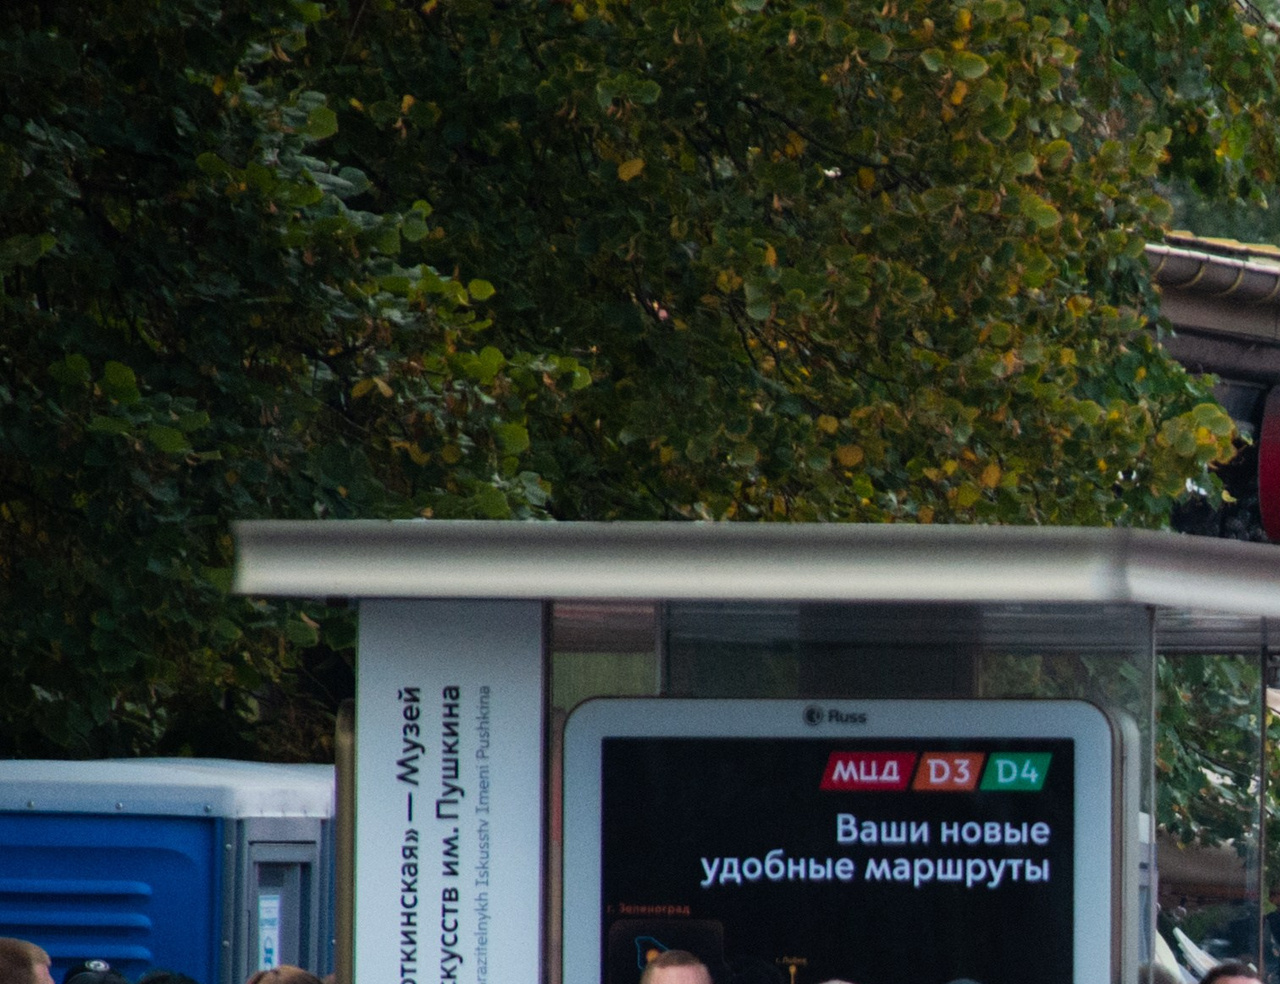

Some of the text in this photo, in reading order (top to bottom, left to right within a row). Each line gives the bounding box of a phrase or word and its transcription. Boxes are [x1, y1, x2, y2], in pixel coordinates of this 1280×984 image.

[395, 686, 426, 787] Музей
[476, 685, 492, 760] Pushkina
[828, 708, 868, 725] Russ
[436, 685, 466, 821] Пушкина
[832, 758, 1038, 784] МЦД D3 D4
[475, 765, 491, 815] Imeni
[440, 826, 460, 877] им.
[475, 820, 491, 887] Iskusstv
[836, 813, 1051, 845] Ваши новые
[700, 849, 1050, 888] удобные маршруты
[619, 901, 691, 916] Зеленоград
